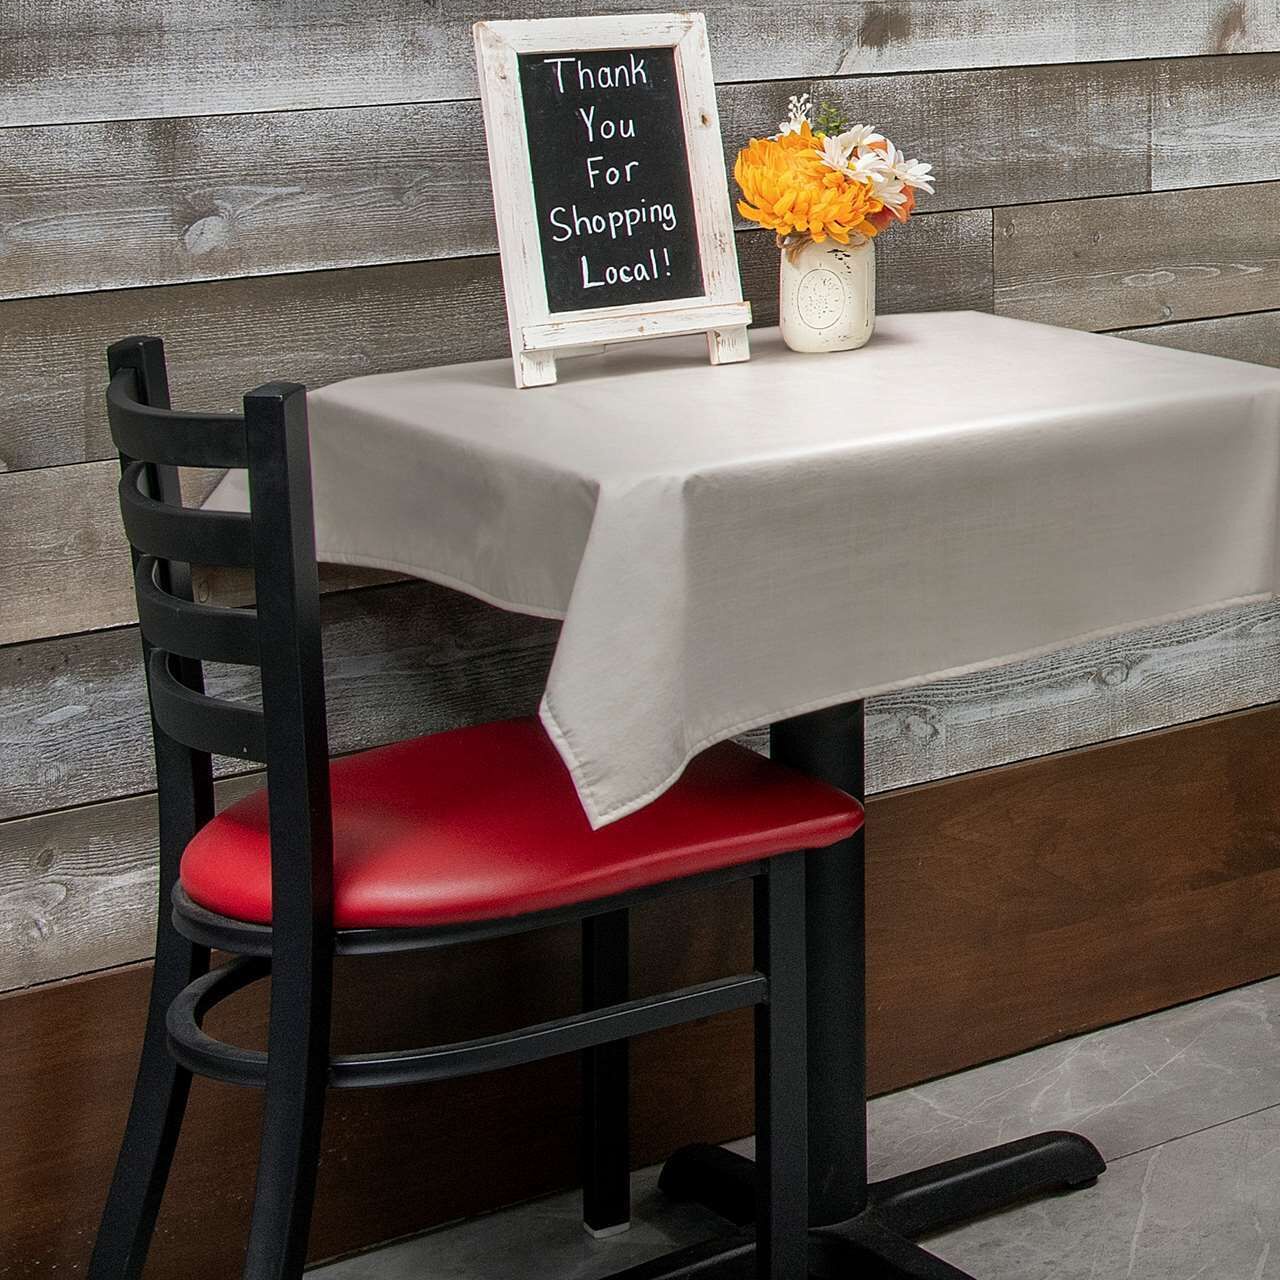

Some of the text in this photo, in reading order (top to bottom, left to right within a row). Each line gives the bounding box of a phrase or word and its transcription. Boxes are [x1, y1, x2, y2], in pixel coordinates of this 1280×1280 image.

[543, 53, 649, 94] Thank
[578, 105, 637, 143] You
[586, 155, 640, 190] For
[549, 197, 678, 243] Shopping
[580, 246, 672, 290] Local!
